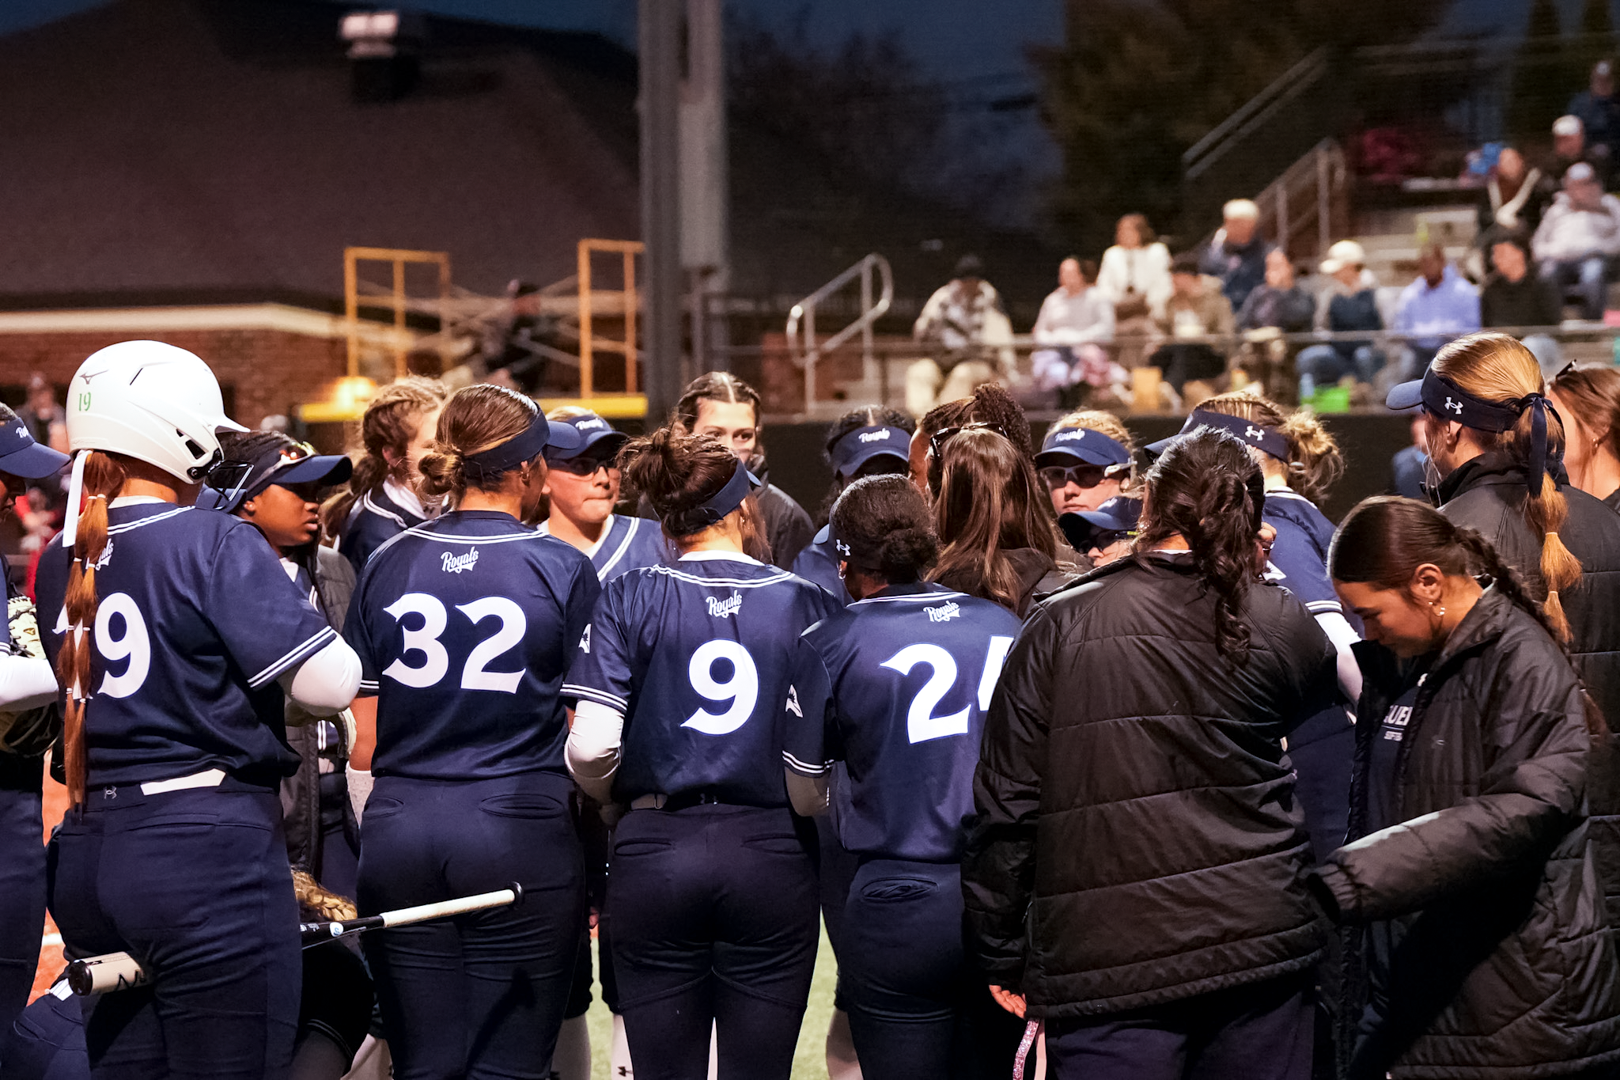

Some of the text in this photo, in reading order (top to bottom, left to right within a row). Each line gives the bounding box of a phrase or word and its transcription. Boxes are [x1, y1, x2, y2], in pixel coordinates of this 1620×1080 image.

[79, 392, 91, 411] 19
[441, 546, 479, 574] Royals
[706, 589, 742, 618] Royals
[923, 600, 961, 622] Royals
[382, 592, 527, 695] 32
[680, 639, 759, 735] 9
